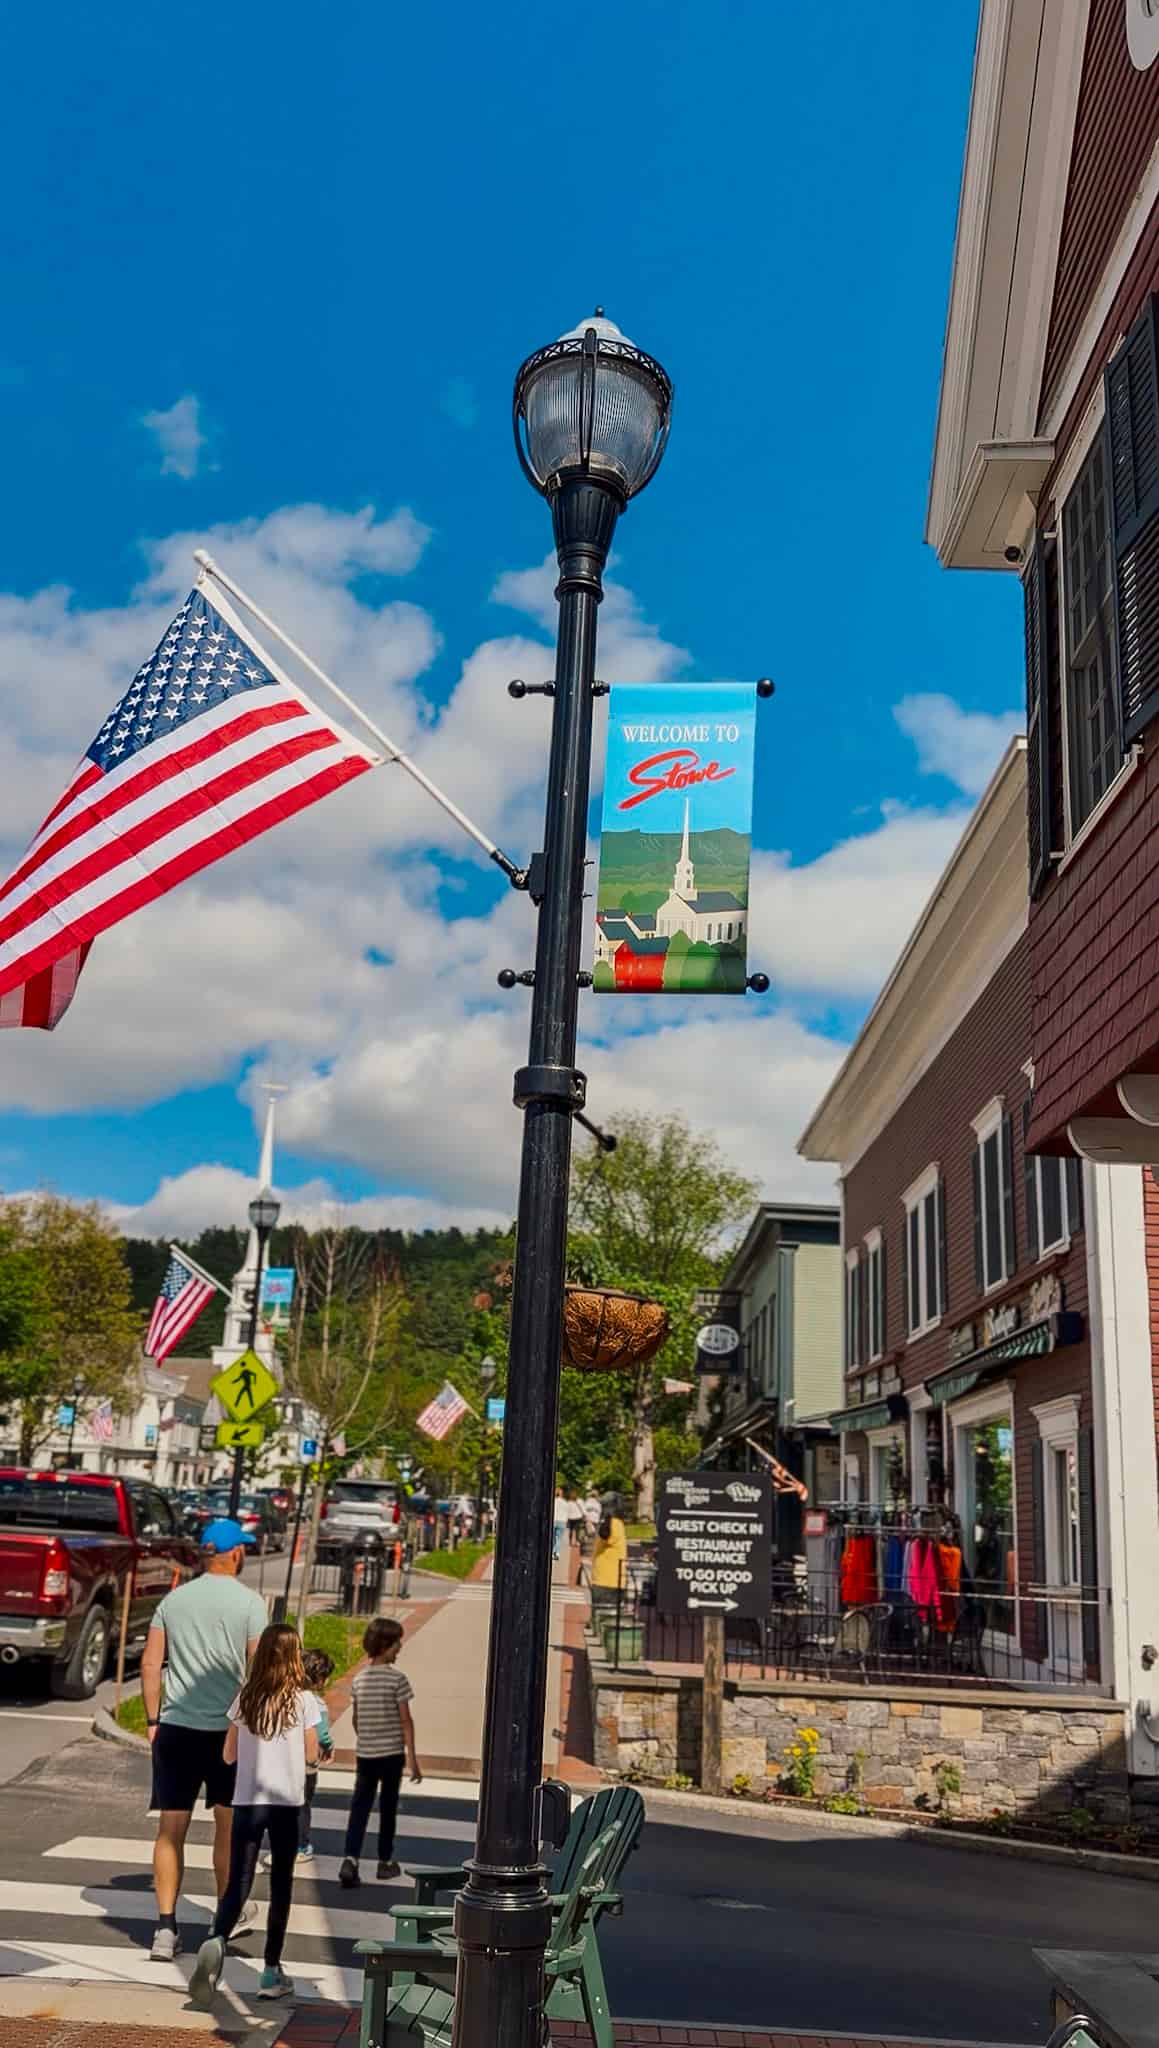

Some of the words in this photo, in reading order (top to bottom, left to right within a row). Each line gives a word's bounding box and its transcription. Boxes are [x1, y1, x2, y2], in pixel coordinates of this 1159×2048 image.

[622, 724, 710, 742] WELCOME
[715, 724, 740, 742] TO
[617, 749, 736, 810] Stowe
[665, 1519, 706, 1533] GUEST
[707, 1521, 748, 1535] CHECK
[749, 1523, 764, 1535] IN
[675, 1538, 753, 1553] RESTAURANT
[681, 1551, 747, 1565] ENTRANCE
[675, 1568, 694, 1580] TO
[695, 1569, 715, 1581] GO
[716, 1570, 753, 1583] FOOD
[690, 1581, 720, 1594] PICK
[719, 1583, 738, 1594] UP
